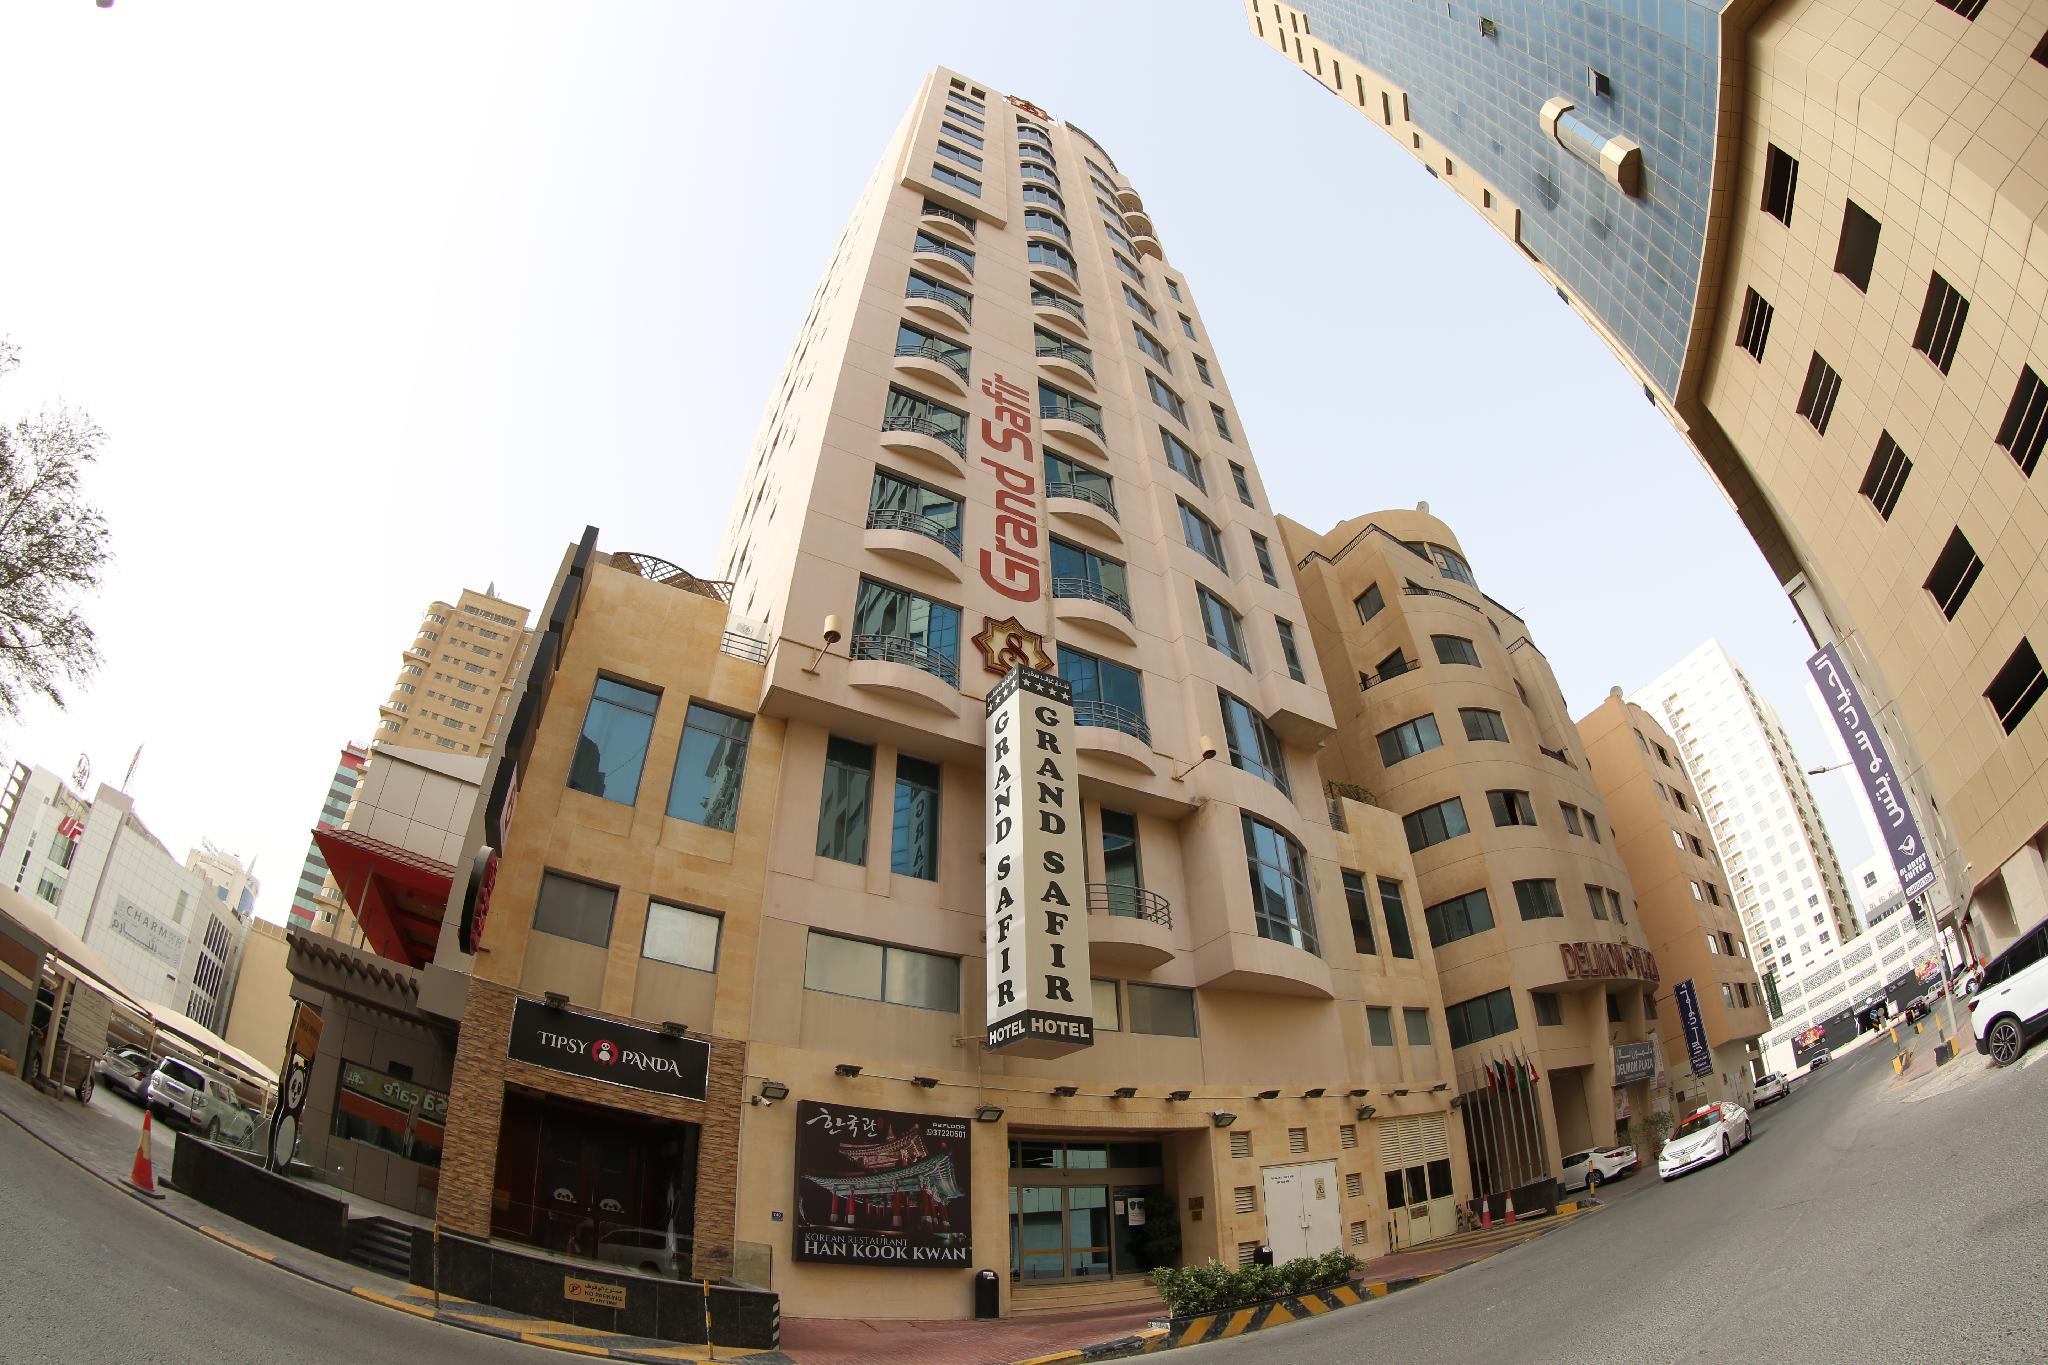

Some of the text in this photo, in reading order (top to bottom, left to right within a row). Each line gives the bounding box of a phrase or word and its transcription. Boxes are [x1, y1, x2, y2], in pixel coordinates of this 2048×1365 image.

[979, 373, 1041, 603] Grand Safir
[994, 710, 1016, 1008] GRAND SAFIR
[1034, 706, 1074, 1004] GRAND SAFIR
[127, 905, 168, 938] CHARM
[989, 1018, 1026, 1047] HOTEL
[1031, 1017, 1090, 1039] HOTEL
[537, 1030, 683, 1078] TIPSY PANDA
[806, 1108, 878, 1138] 한국관
[804, 1232, 908, 1247] KOREAN RESTAURANT
[804, 1240, 967, 1261] HAN KOOK KWAN
[595, 1292, 623, 1302] PARKING
